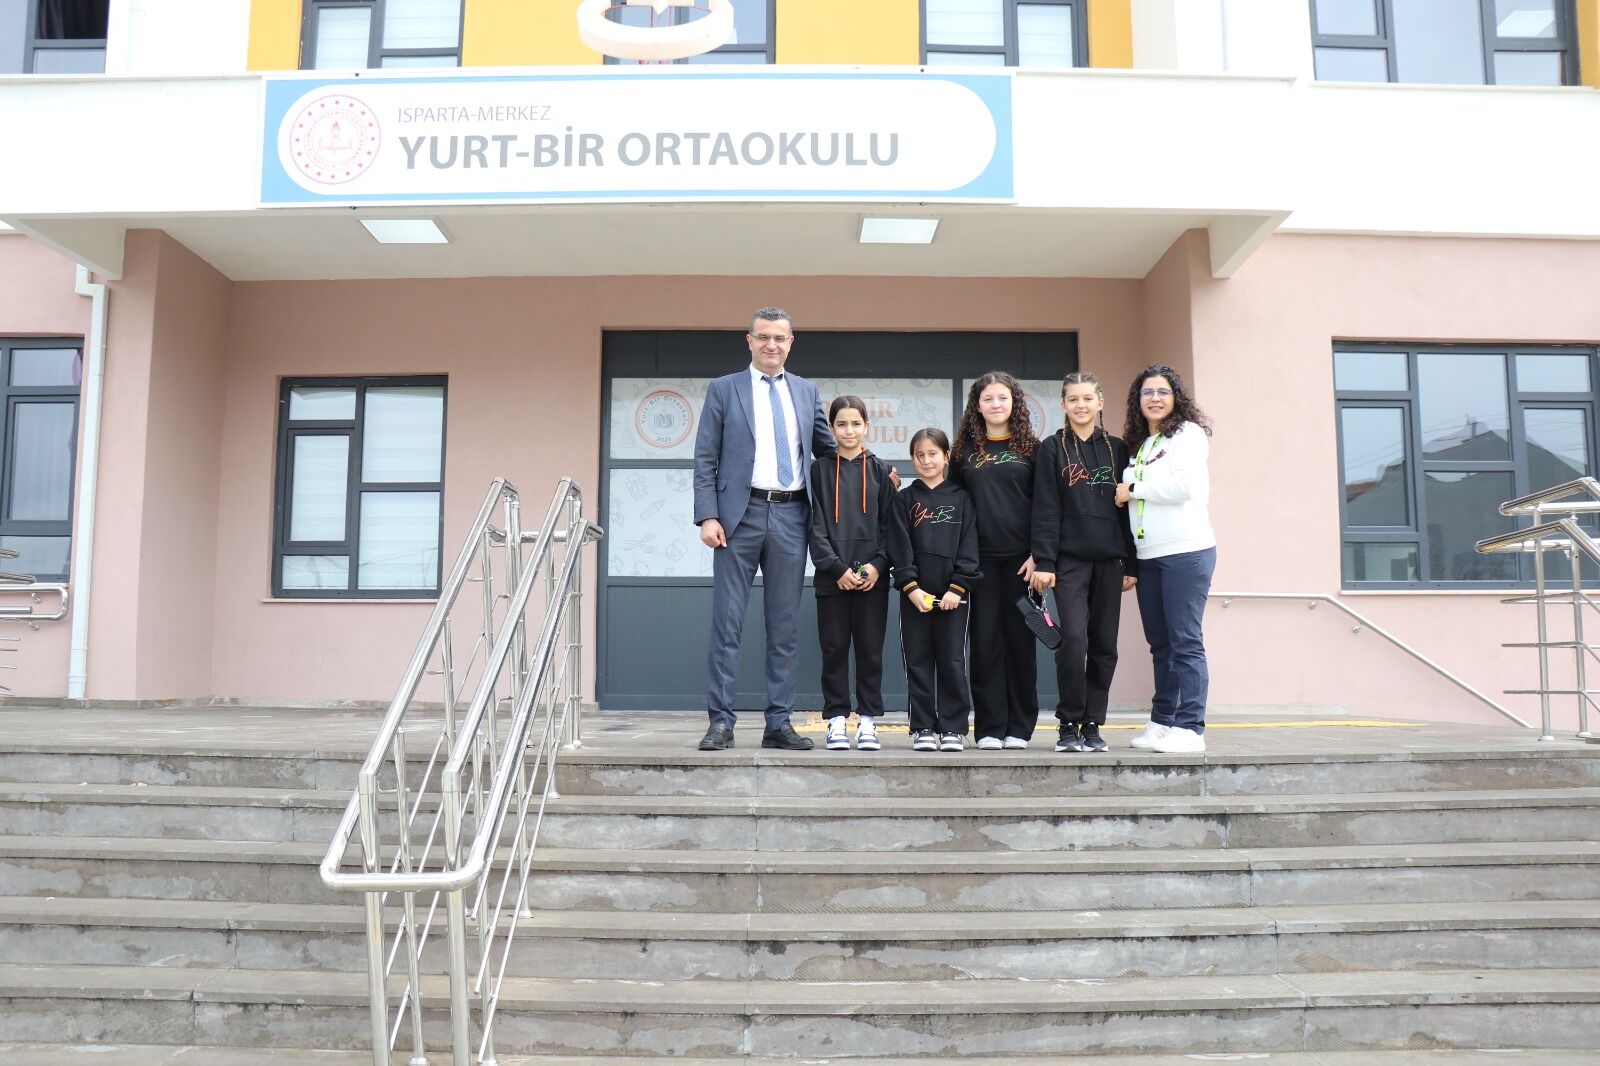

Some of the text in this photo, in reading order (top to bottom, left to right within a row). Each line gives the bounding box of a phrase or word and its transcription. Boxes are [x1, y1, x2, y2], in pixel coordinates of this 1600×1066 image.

[398, 105, 552, 123] ISPARTA-MERKEZ
[398, 125, 604, 169] YURT-BİR
[617, 131, 899, 167] ORTAOKULU
